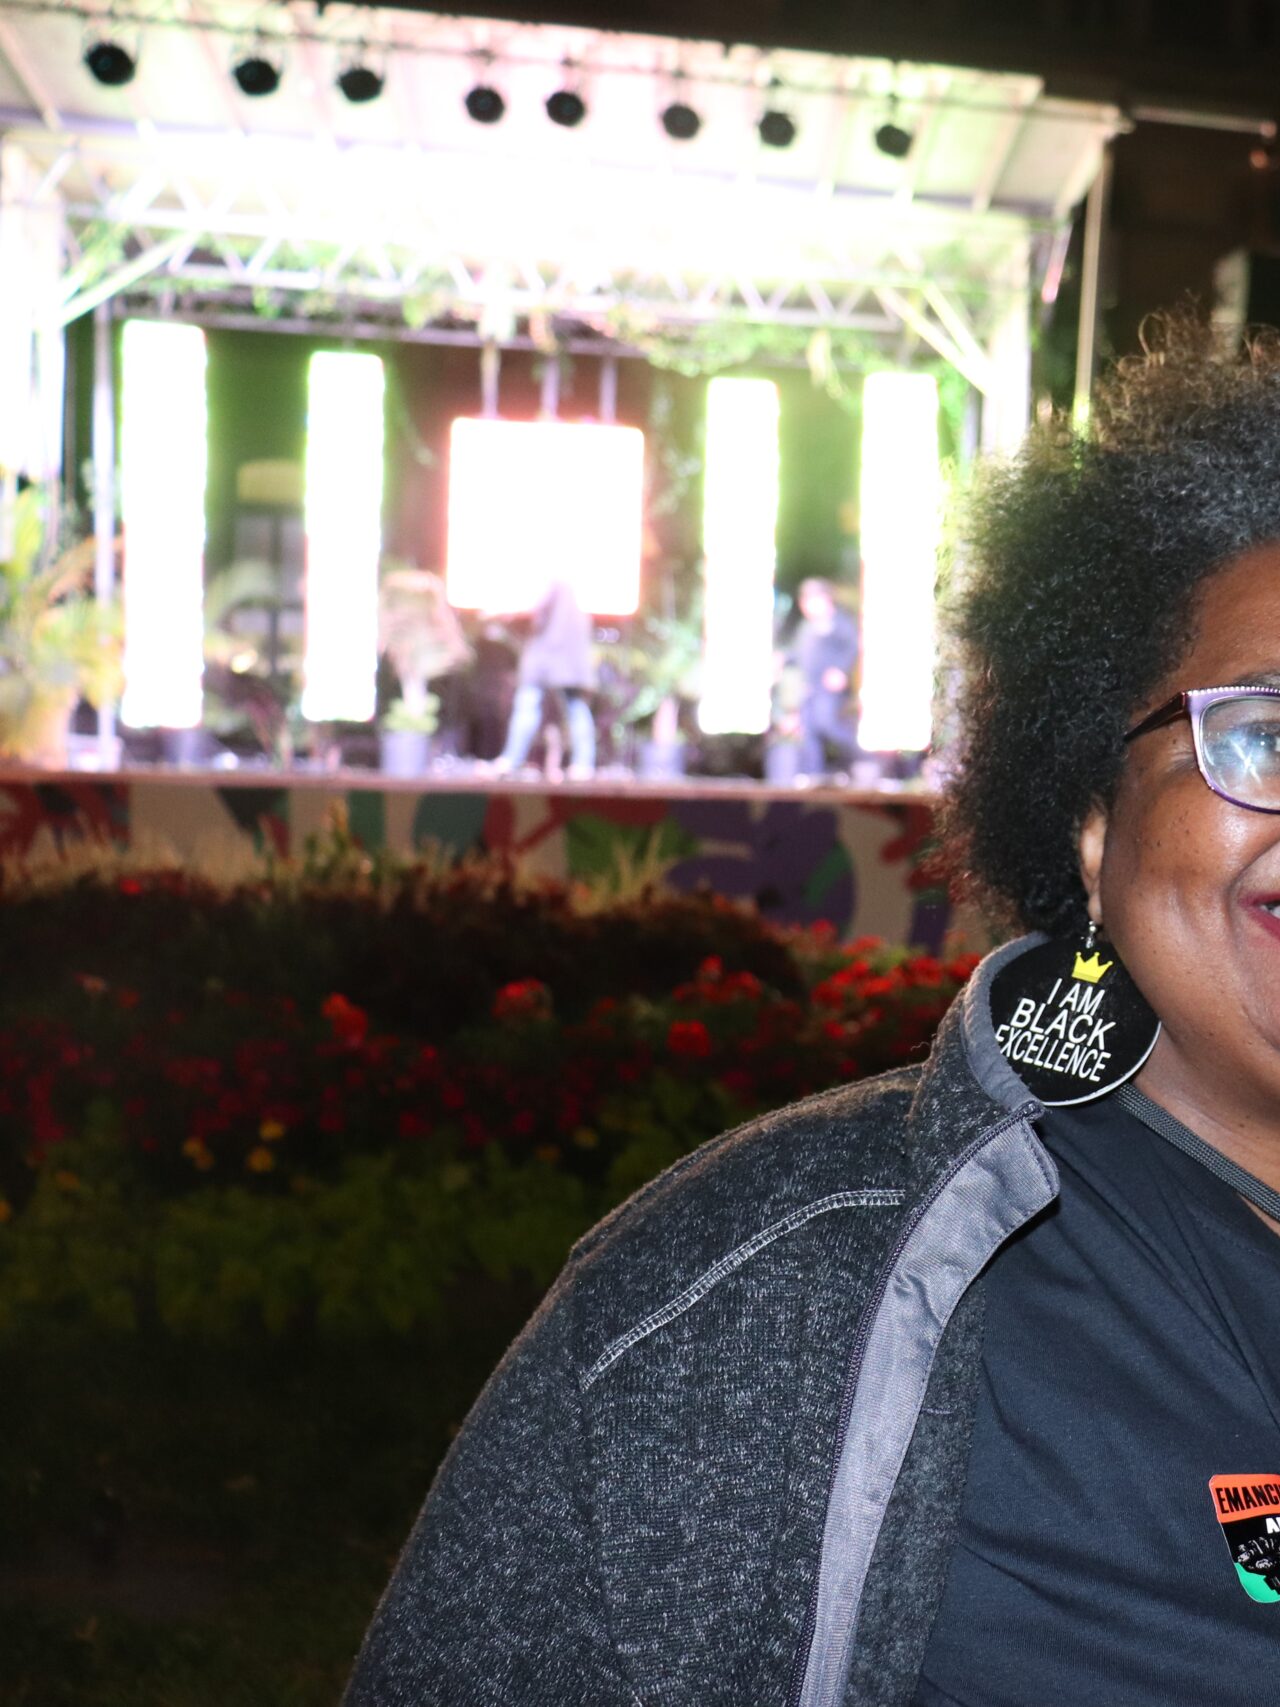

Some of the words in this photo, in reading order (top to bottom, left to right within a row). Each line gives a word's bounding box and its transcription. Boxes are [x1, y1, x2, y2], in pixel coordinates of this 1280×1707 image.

[1047, 978, 1063, 1005] I
[1058, 982, 1106, 1017] AM
[1010, 997, 1117, 1050] BLACK
